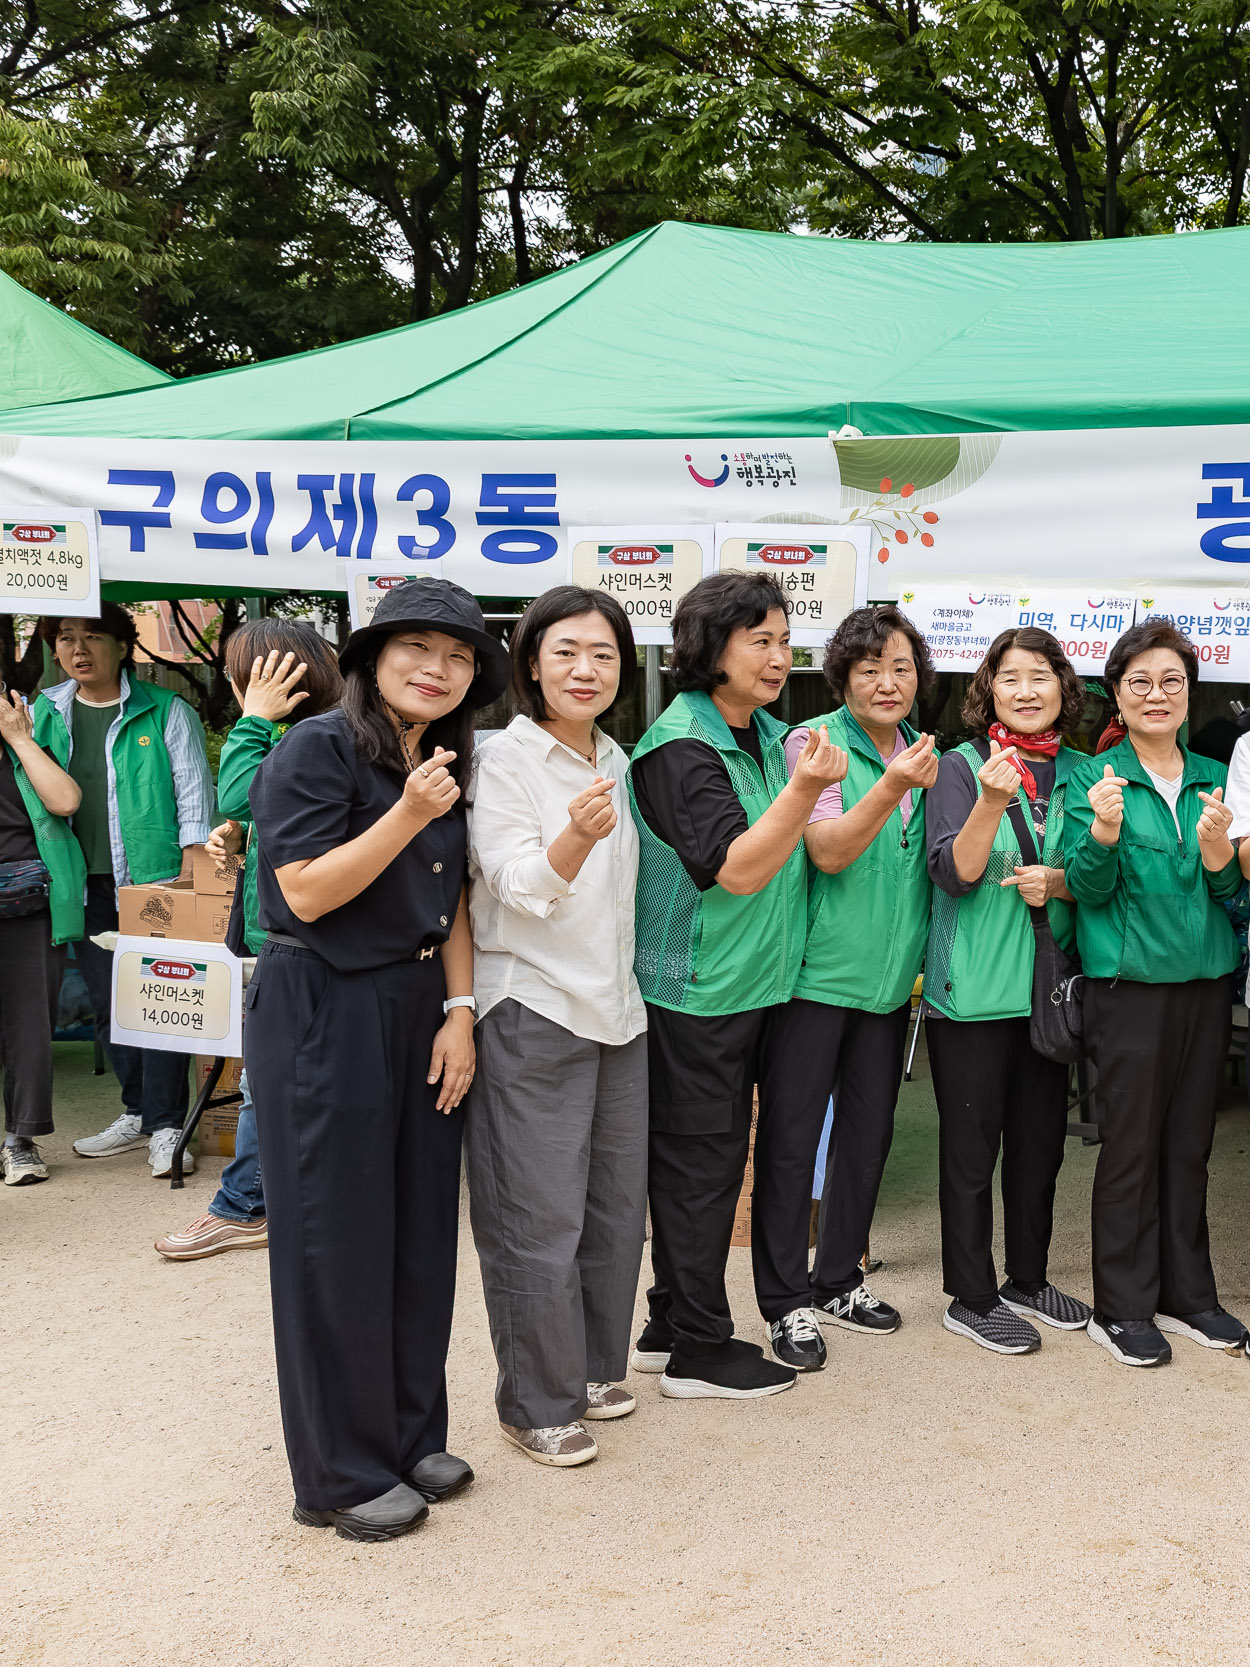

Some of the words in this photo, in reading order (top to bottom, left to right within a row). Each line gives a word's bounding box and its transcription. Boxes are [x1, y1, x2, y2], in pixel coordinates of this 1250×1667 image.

[736, 465, 796, 488] 행복광진
[97, 468, 561, 565] 구의제3동
[47, 550, 83, 569] 4.8kg
[616, 551, 630, 561] 구삼
[632, 551, 653, 561] 부녀회
[766, 550, 781, 560] 구삼
[783, 550, 806, 561] 부녀회
[6, 573, 68, 591] 20,000원
[598, 572, 672, 592] 샤인머스켓
[773, 571, 815, 592] 시송편
[624, 599, 672, 618] 000원
[786, 600, 823, 620] 00원
[930, 622, 972, 632] 새마을금고
[1018, 612, 1057, 632] 미역,
[1070, 614, 1125, 633] 다시마
[926, 635, 990, 646] 희(광장동부녀회)
[930, 649, 986, 660] 2075-4249
[140, 983, 204, 1007] 샤인머스켓
[142, 1008, 204, 1030] 14,000원
